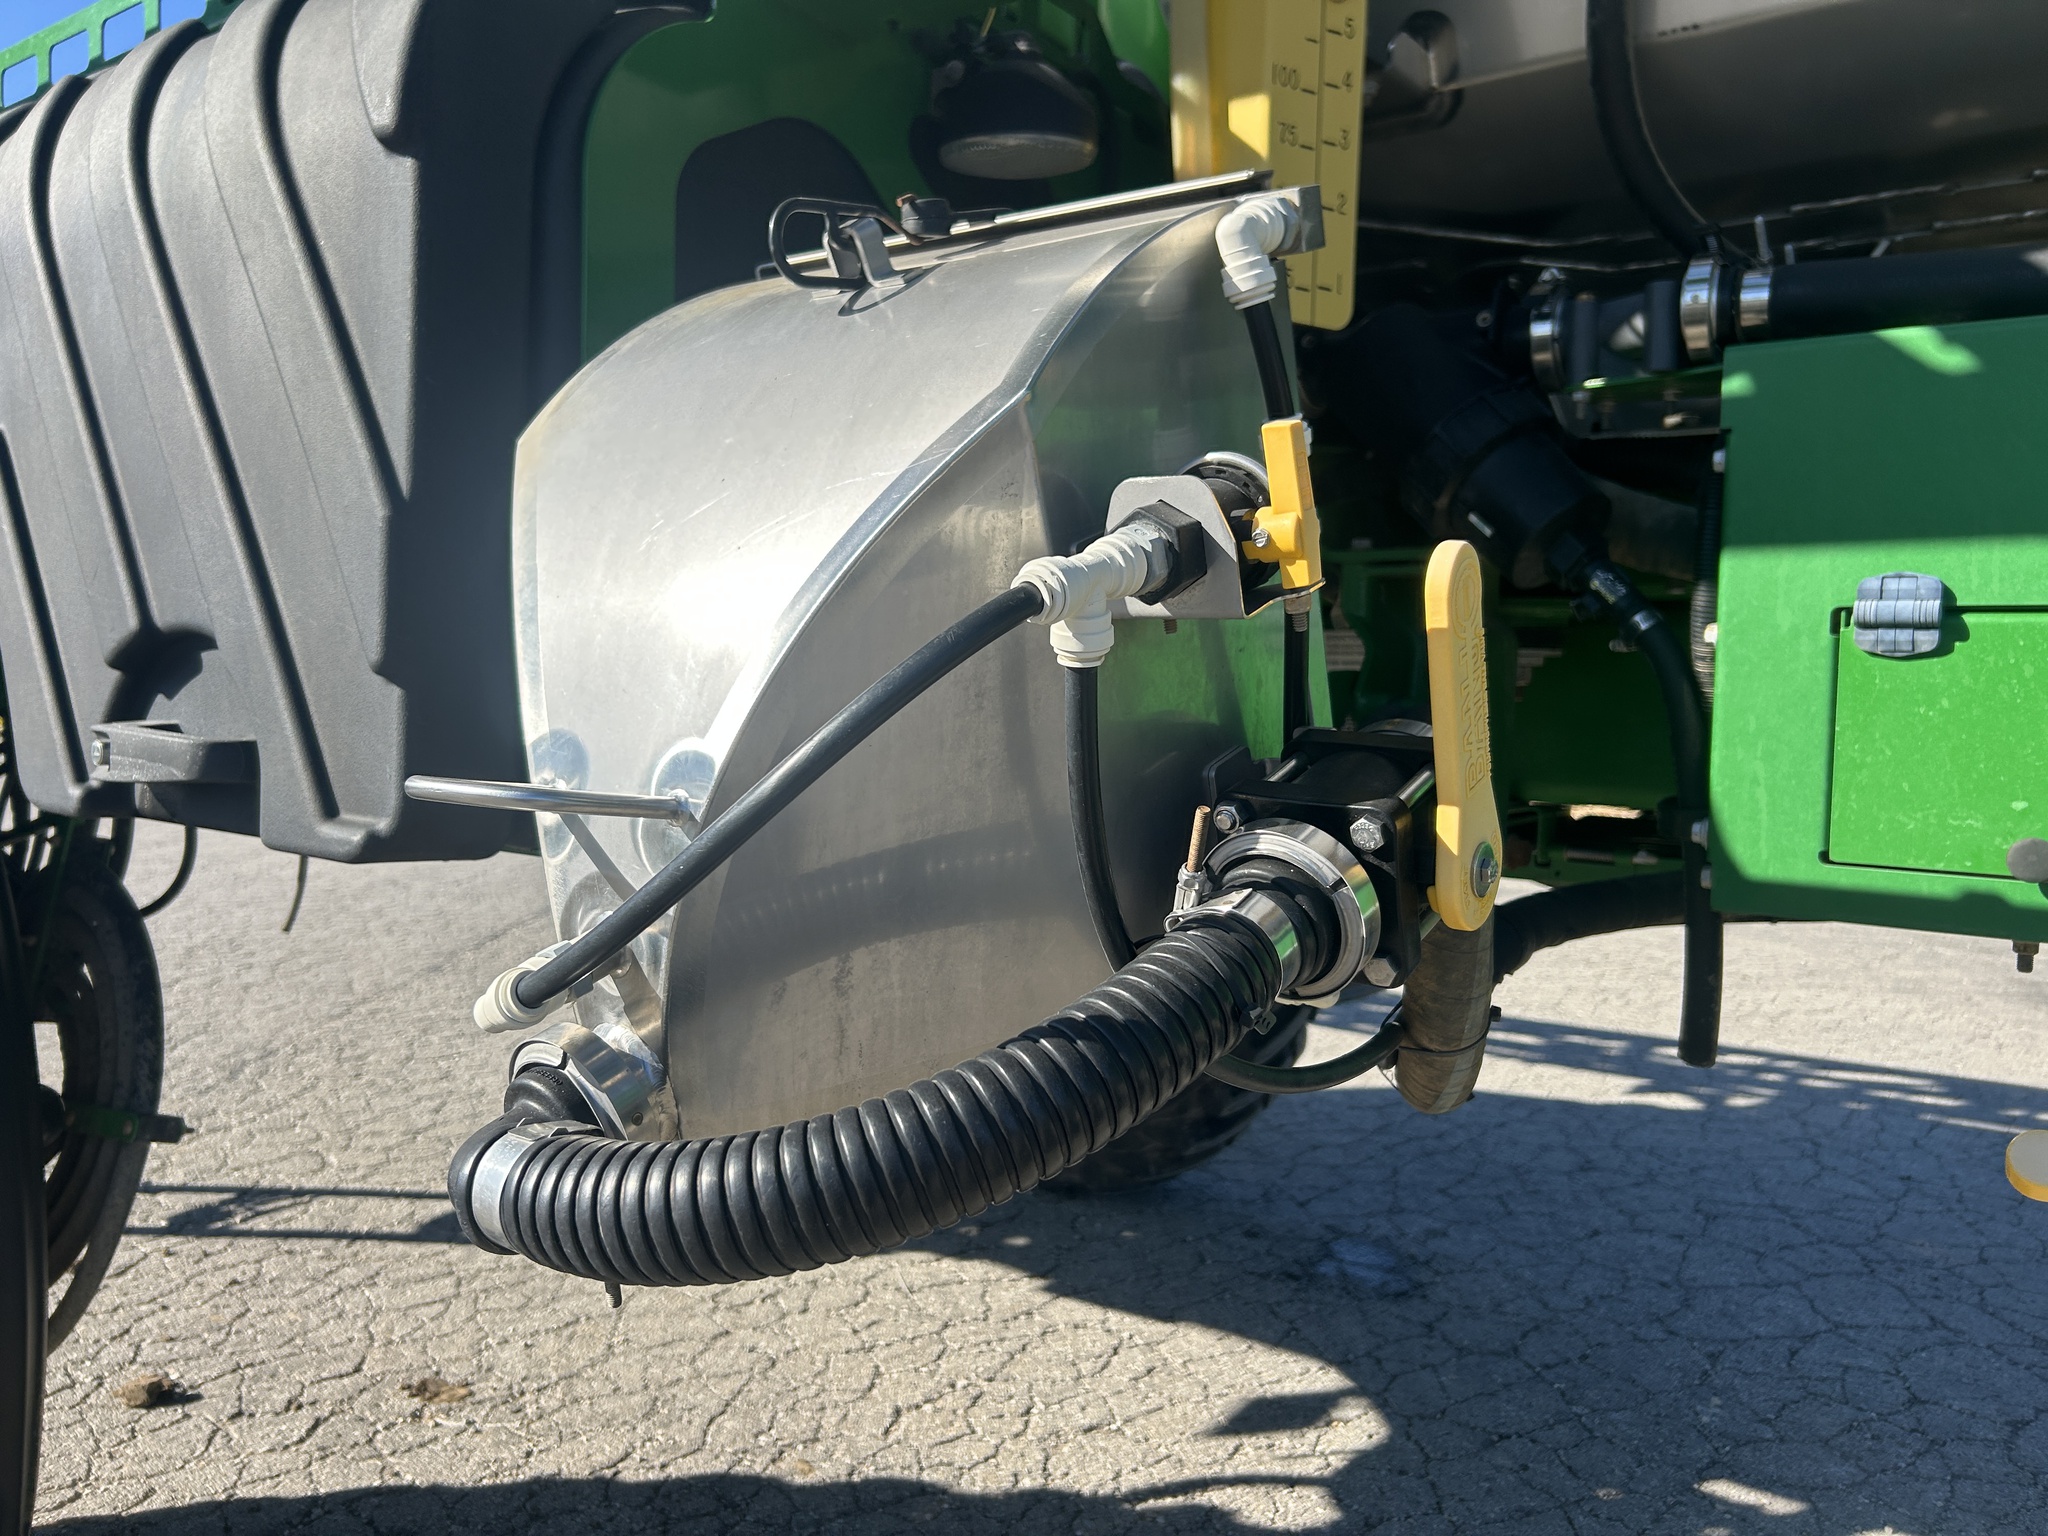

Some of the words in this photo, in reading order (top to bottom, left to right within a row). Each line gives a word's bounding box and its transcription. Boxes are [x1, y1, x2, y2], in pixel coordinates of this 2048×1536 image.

[1344, 16, 1356, 40] 5
[1271, 61, 1301, 91] 100
[1342, 71, 1353, 93] 4
[1277, 121, 1299, 147] 75
[1338, 127, 1351, 151] 3
[1336, 192, 1347, 215] 2
[1451, 556, 1487, 799] BANJO
